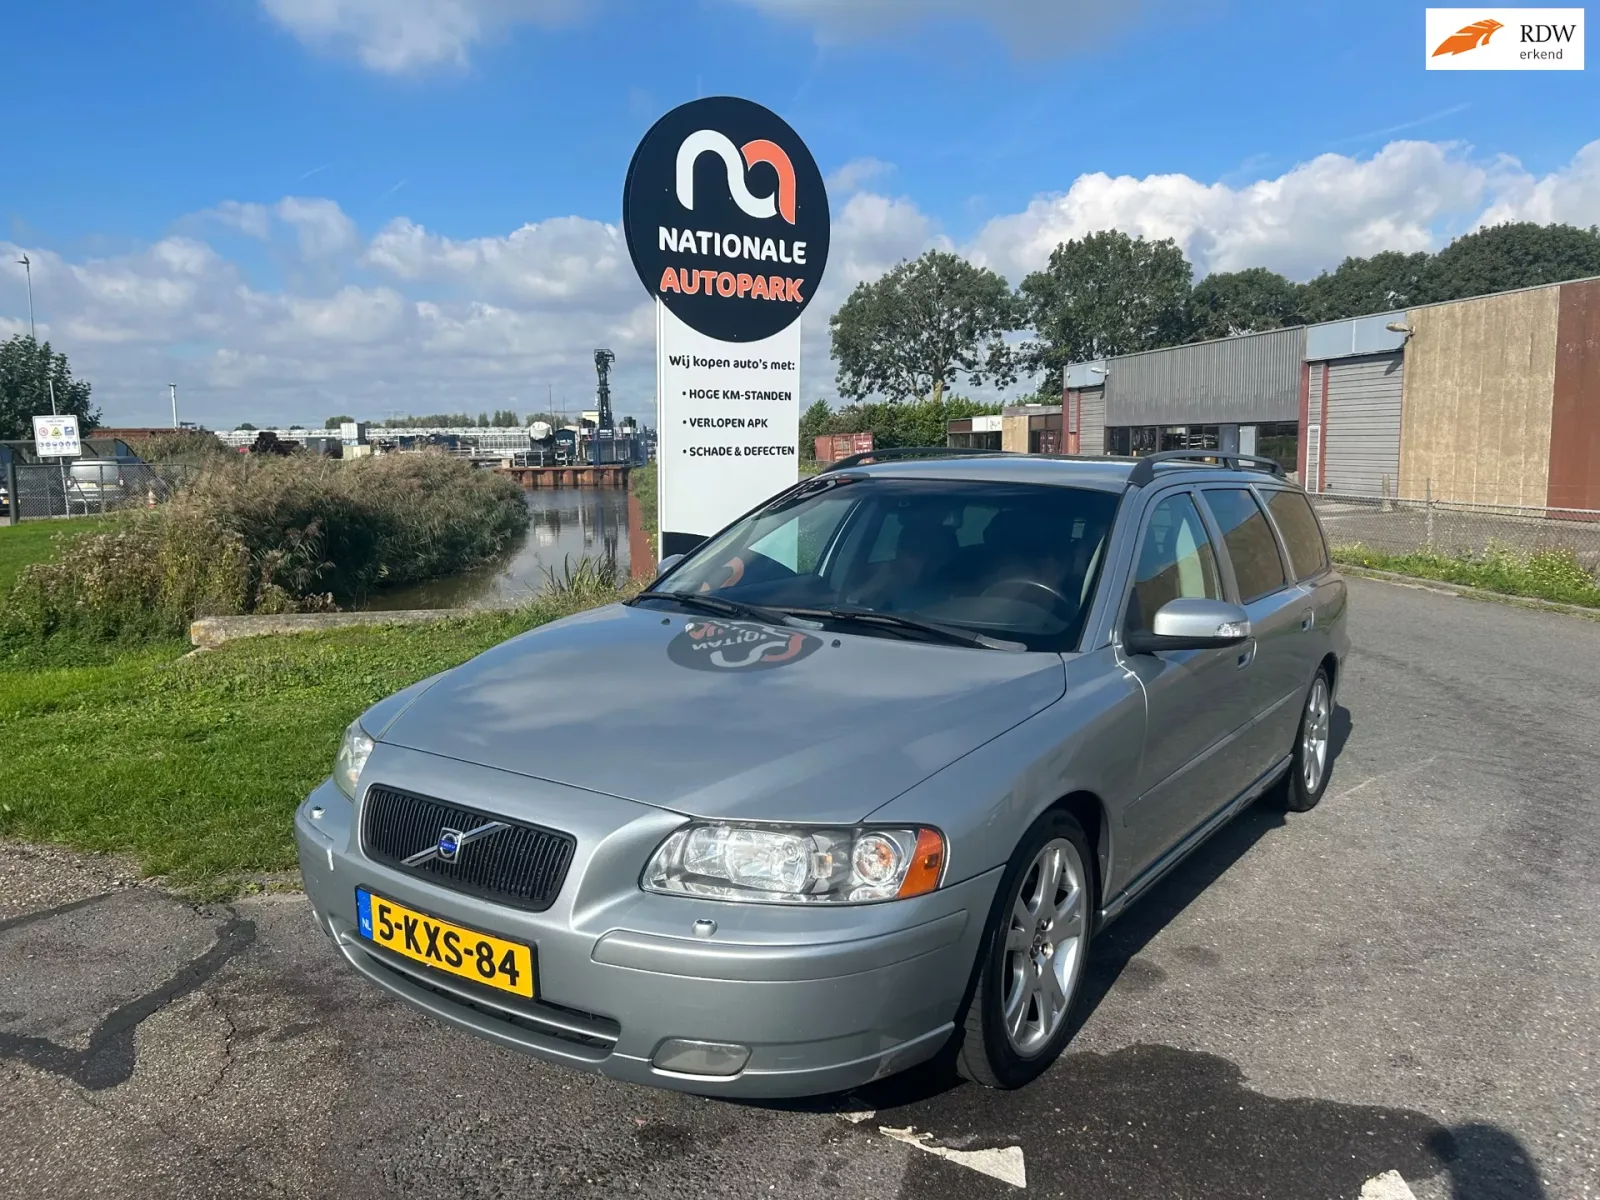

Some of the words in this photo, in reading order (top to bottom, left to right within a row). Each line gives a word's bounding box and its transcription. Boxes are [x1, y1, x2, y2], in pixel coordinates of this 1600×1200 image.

[659, 226, 807, 264] NATIONALE
[660, 267, 804, 303] AUTOPARK
[669, 355, 690, 369] Wij
[693, 355, 730, 369] kopen
[733, 359, 768, 370] auto's
[770, 361, 795, 370] met:
[689, 389, 720, 399] HOGE
[722, 390, 792, 401] KM-STANDEN
[689, 418, 745, 428] VERLOPEN
[747, 418, 768, 428] APK
[689, 447, 733, 456] SCHADE
[734, 447, 742, 456] &
[744, 446, 795, 456] DEFECTEN
[362, 917, 372, 931] NL
[378, 904, 520, 987] 5-KXS-84
